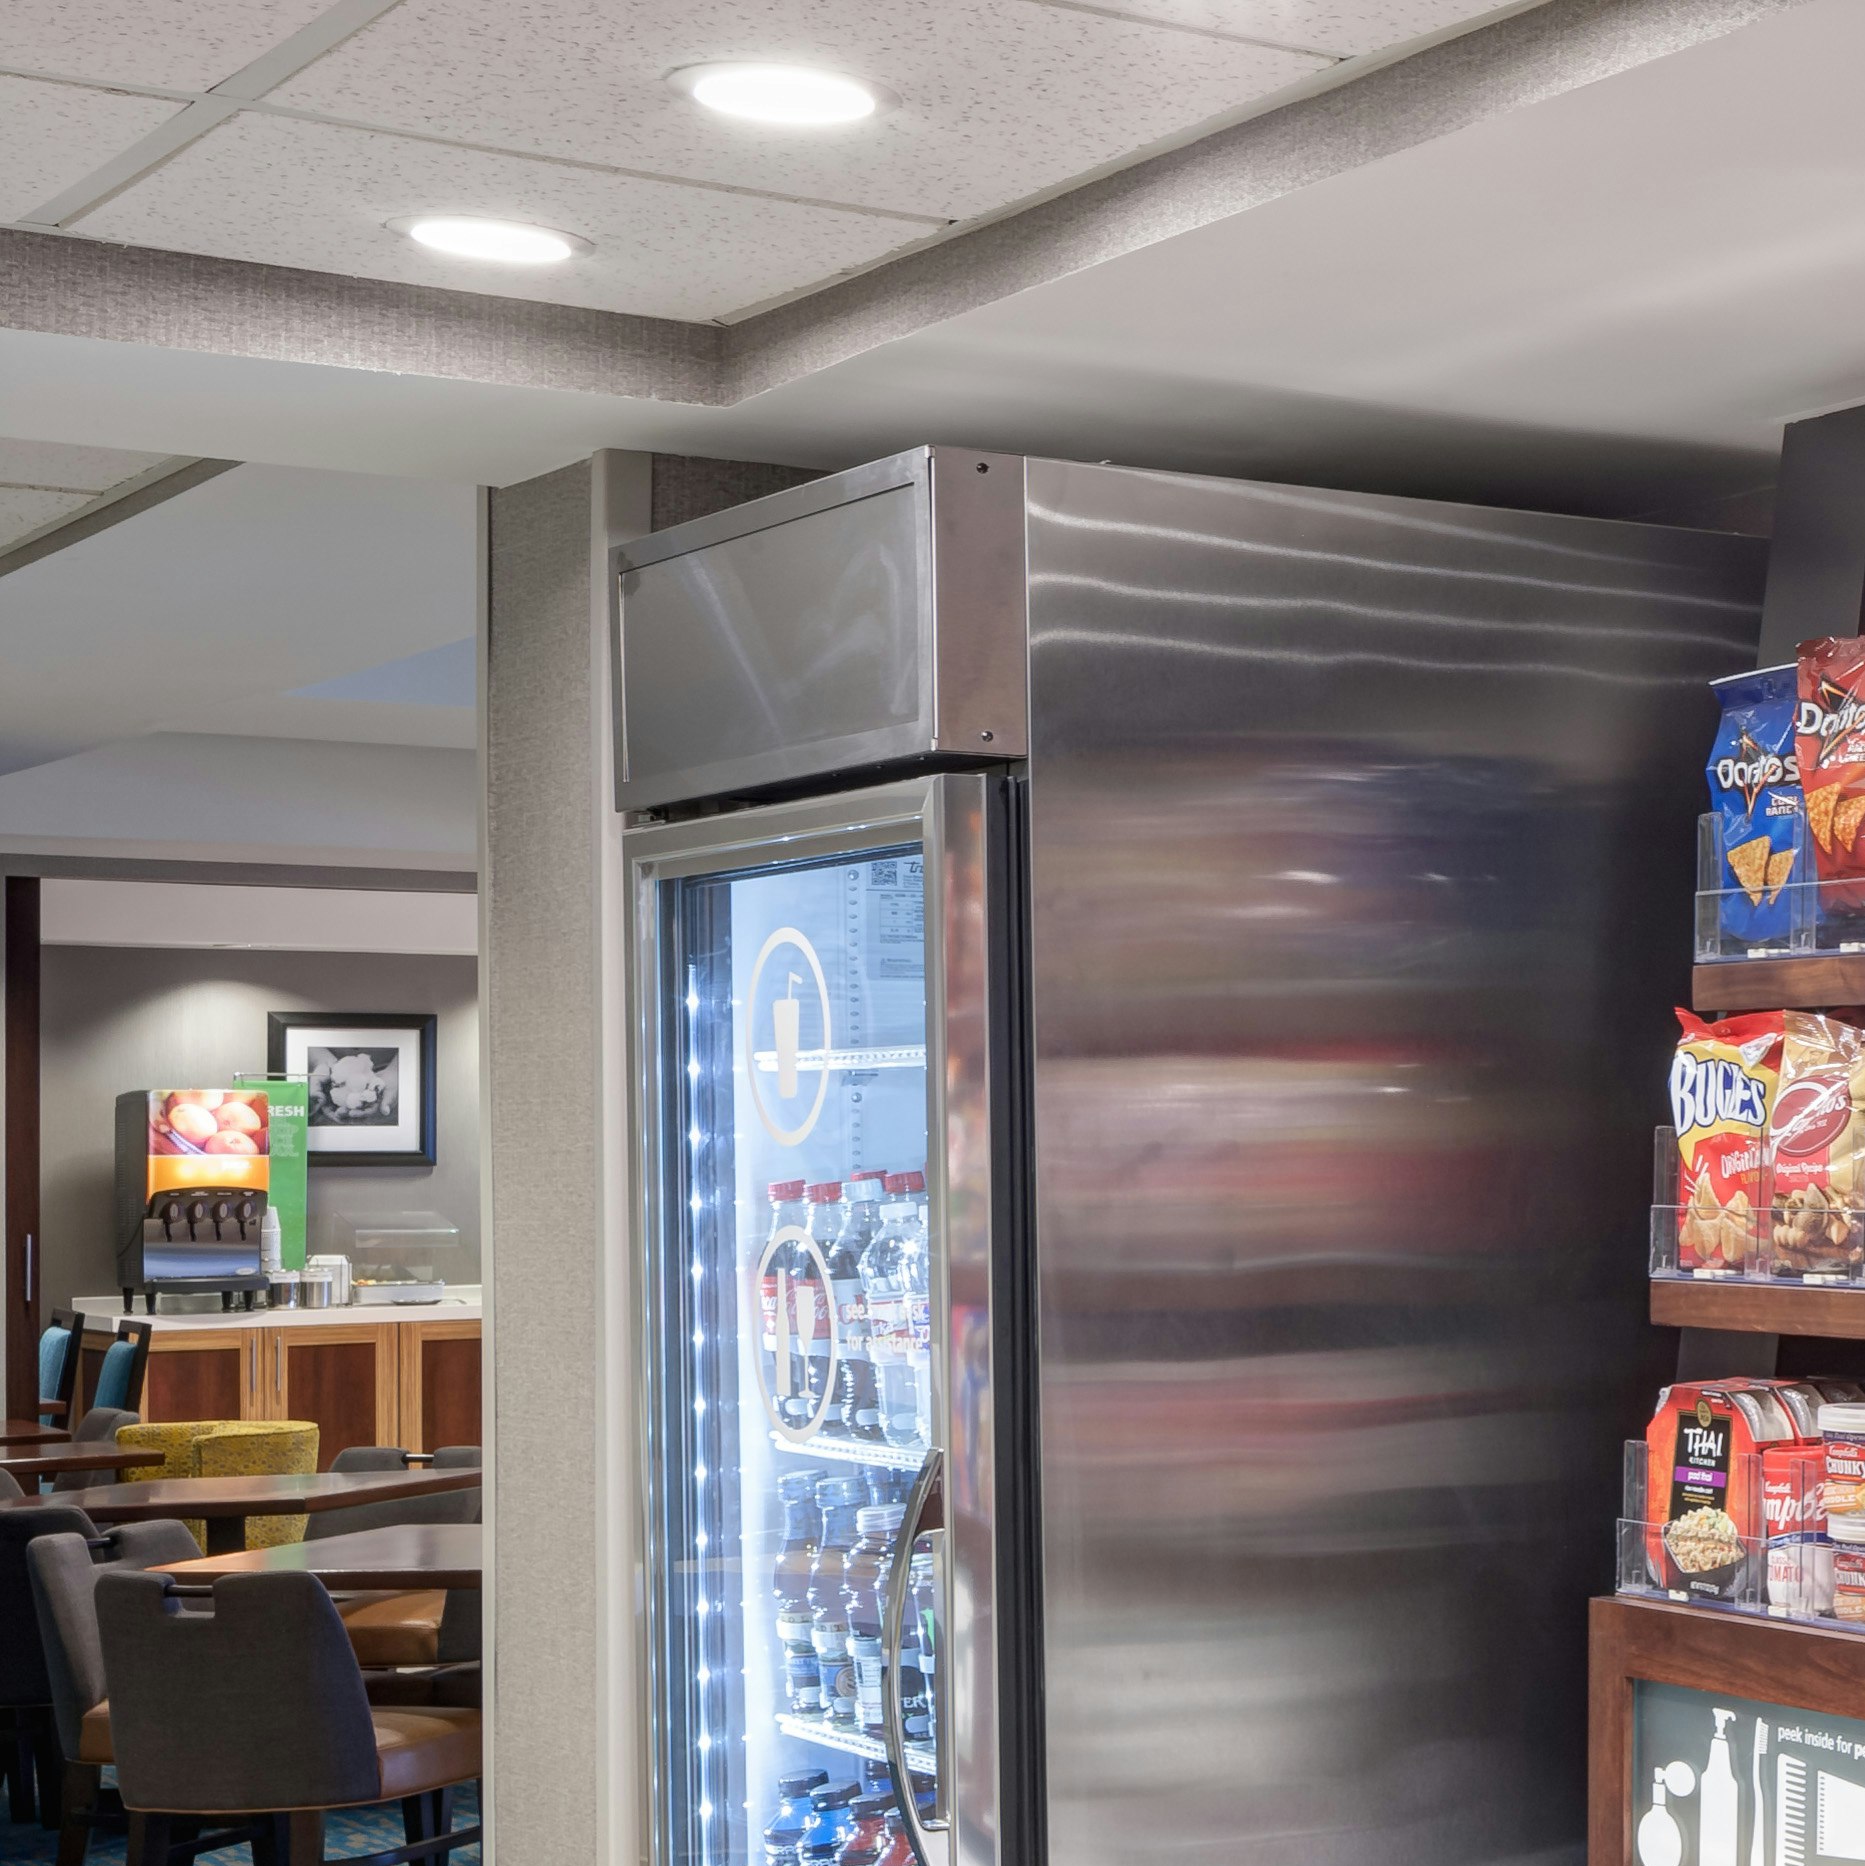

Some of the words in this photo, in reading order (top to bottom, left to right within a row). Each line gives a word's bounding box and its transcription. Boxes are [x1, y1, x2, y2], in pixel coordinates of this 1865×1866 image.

[1670, 1052, 1766, 1138] BUGLES
[1684, 1427, 1724, 1458] THAI
[1778, 1726, 1803, 1743] peek
[1805, 1730, 1834, 1750] inside
[1836, 1737, 1852, 1753] for
